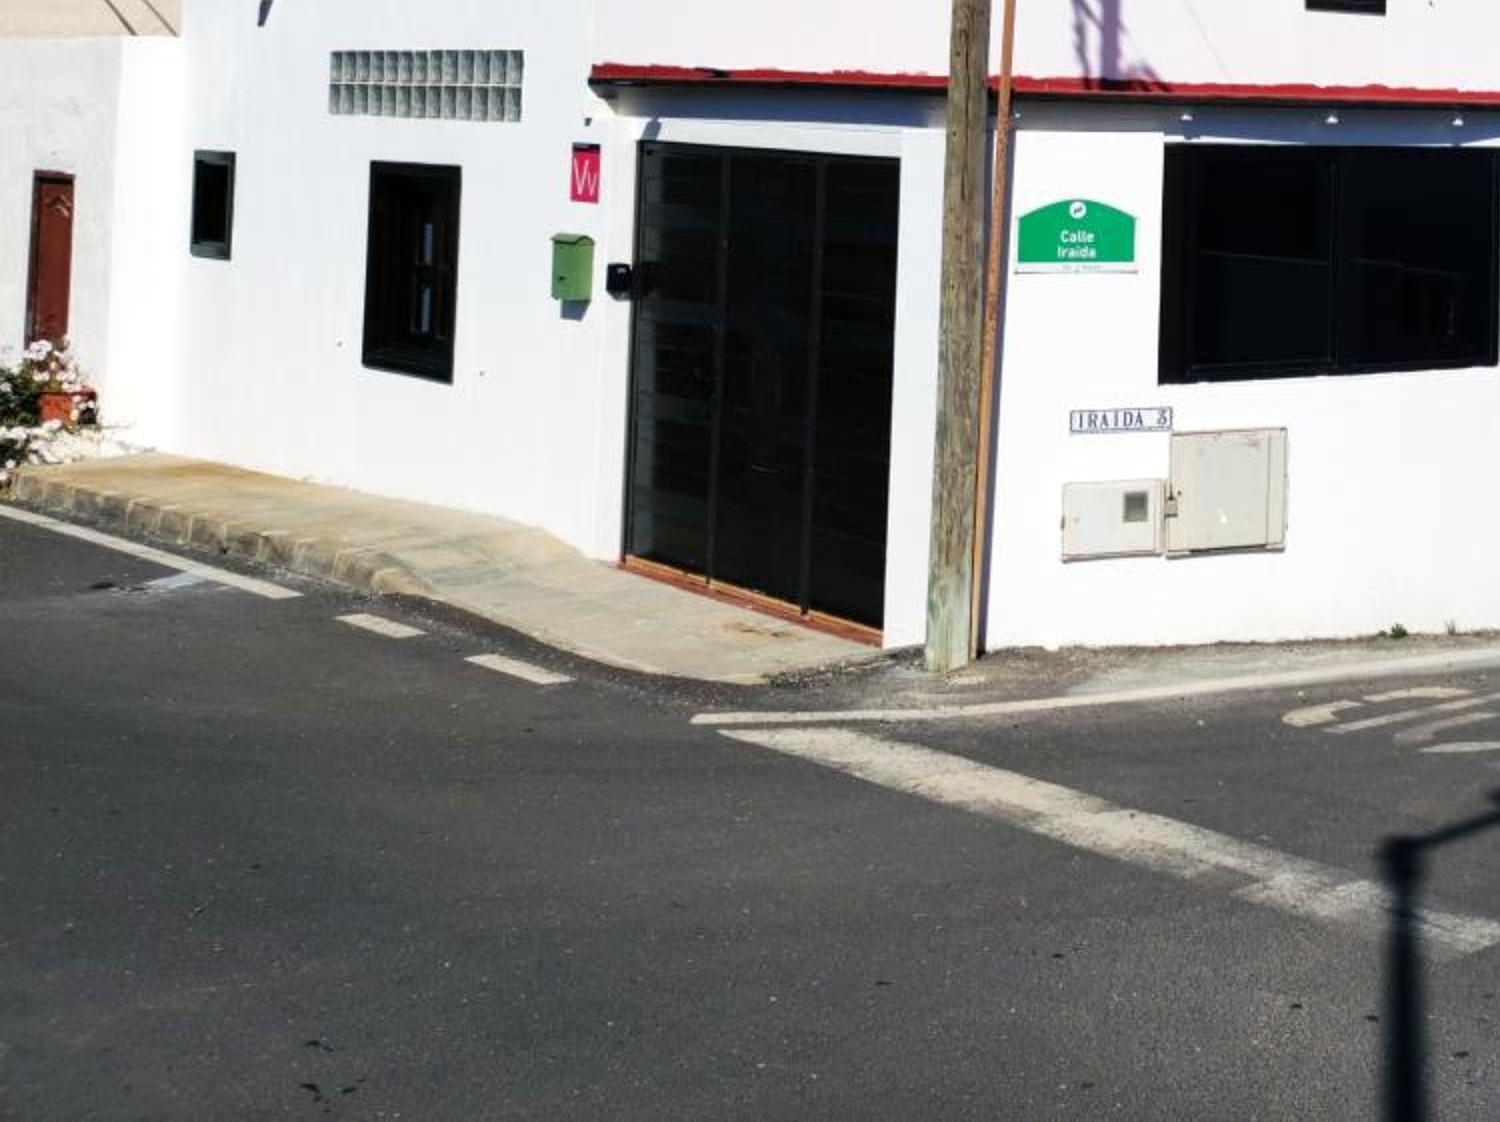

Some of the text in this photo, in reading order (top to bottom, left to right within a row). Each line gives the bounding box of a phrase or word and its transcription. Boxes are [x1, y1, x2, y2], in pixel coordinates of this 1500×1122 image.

[1059, 229, 1095, 243] Calle
[1056, 245, 1097, 259] Iraida
[1077, 410, 1144, 429] IRAIDA
